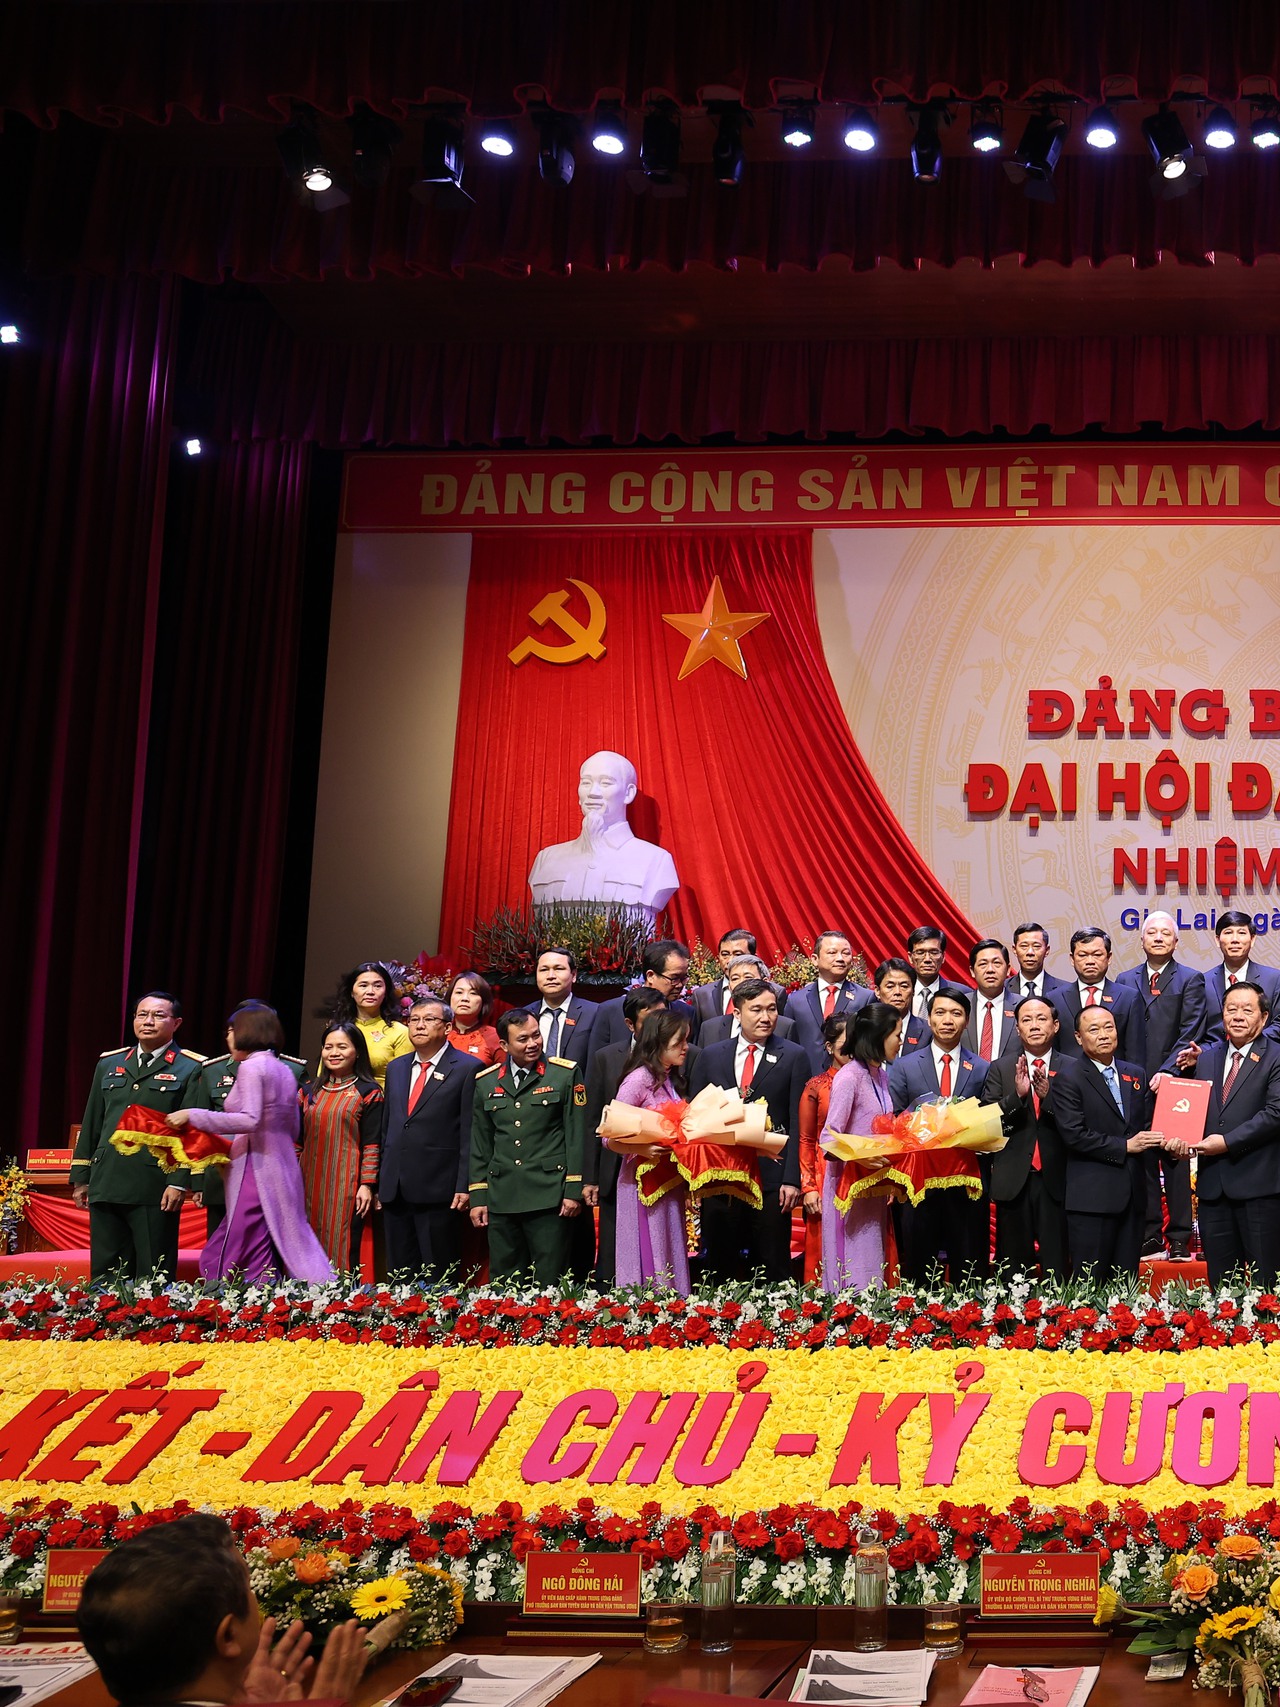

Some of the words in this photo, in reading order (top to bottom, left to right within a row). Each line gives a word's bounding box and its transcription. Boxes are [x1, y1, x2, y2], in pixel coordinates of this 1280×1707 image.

[420, 460, 586, 515] ĐẢNG
[609, 462, 774, 522] CỘNG
[797, 454, 922, 511] SẢN
[946, 457, 1076, 516] VIỆT
[1097, 465, 1239, 506] NAM
[1027, 675, 1229, 733] ĐẢNG
[964, 762, 1078, 829] ĐẠI
[1098, 750, 1211, 829] HỘI
[1177, 908, 1216, 931] Lai
[0, 1361, 226, 1485] KẾT
[241, 1370, 522, 1487] DÂN
[520, 1361, 770, 1487] CHỦ
[829, 1361, 992, 1487] KỶ
[50, 1571, 88, 1587] NGUYỄ
[542, 1576, 566, 1590] NGÔ
[569, 1576, 600, 1590] ĐÔNG
[604, 1574, 623, 1590] HẢI
[984, 1574, 1025, 1591] NGUYỄN
[1028, 1579, 1062, 1594] TRỌNG
[1064, 1576, 1096, 1591] NGHĨA
